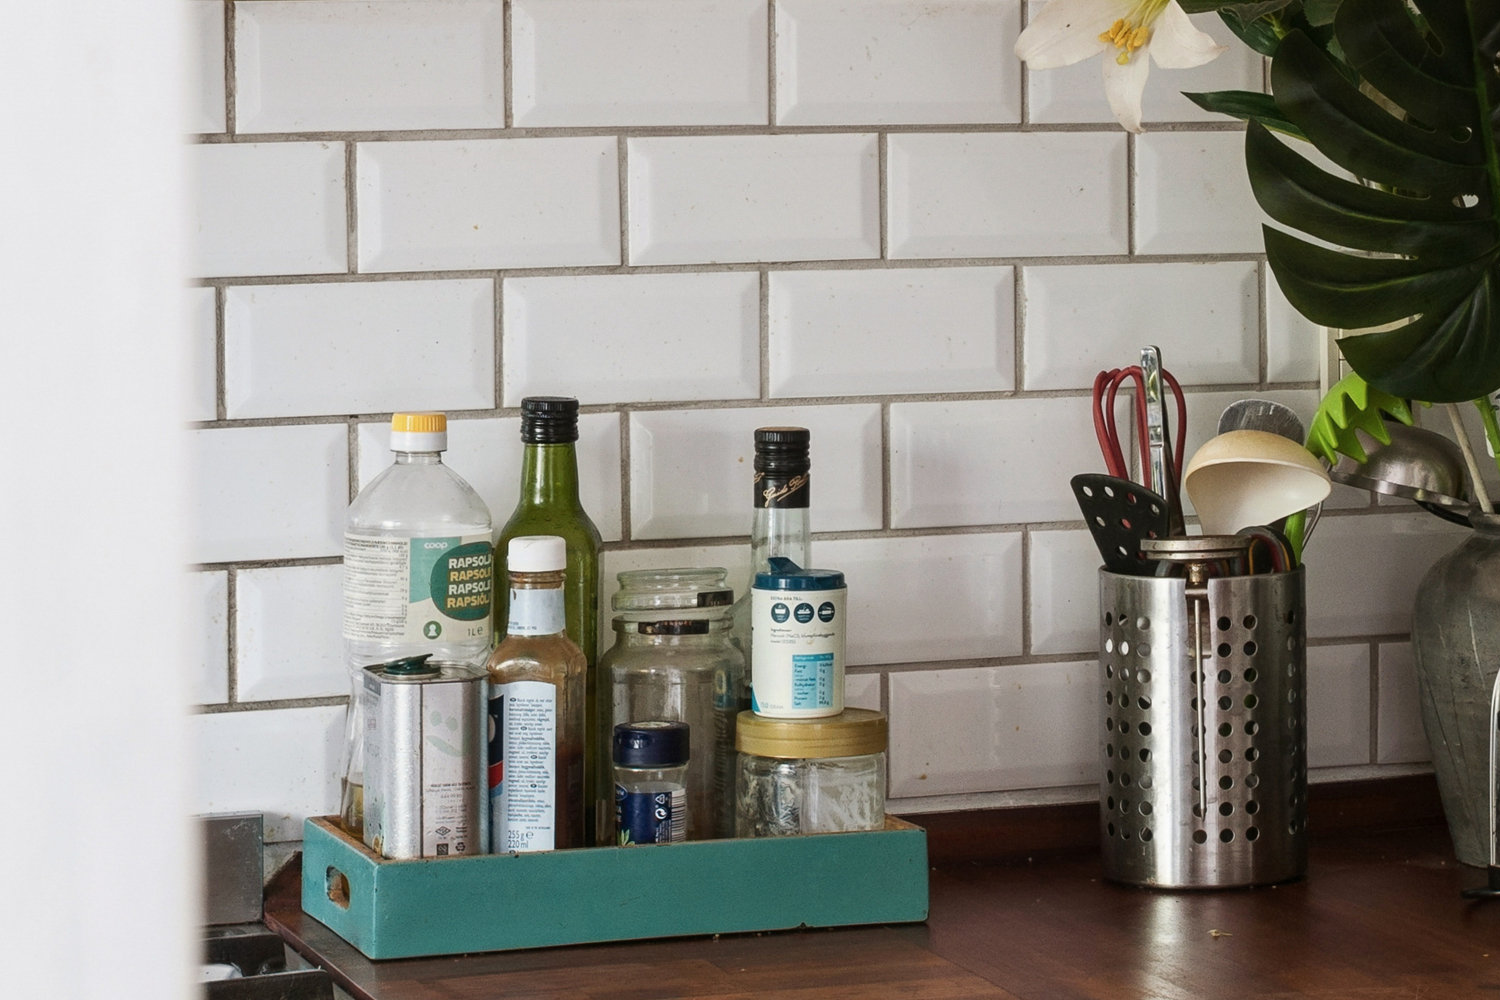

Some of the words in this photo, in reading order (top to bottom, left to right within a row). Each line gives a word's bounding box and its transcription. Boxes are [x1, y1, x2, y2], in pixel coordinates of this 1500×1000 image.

[424, 542, 448, 550] coop
[508, 830, 520, 839] 255
[508, 840, 520, 848] 220
[520, 840, 529, 848] ml
